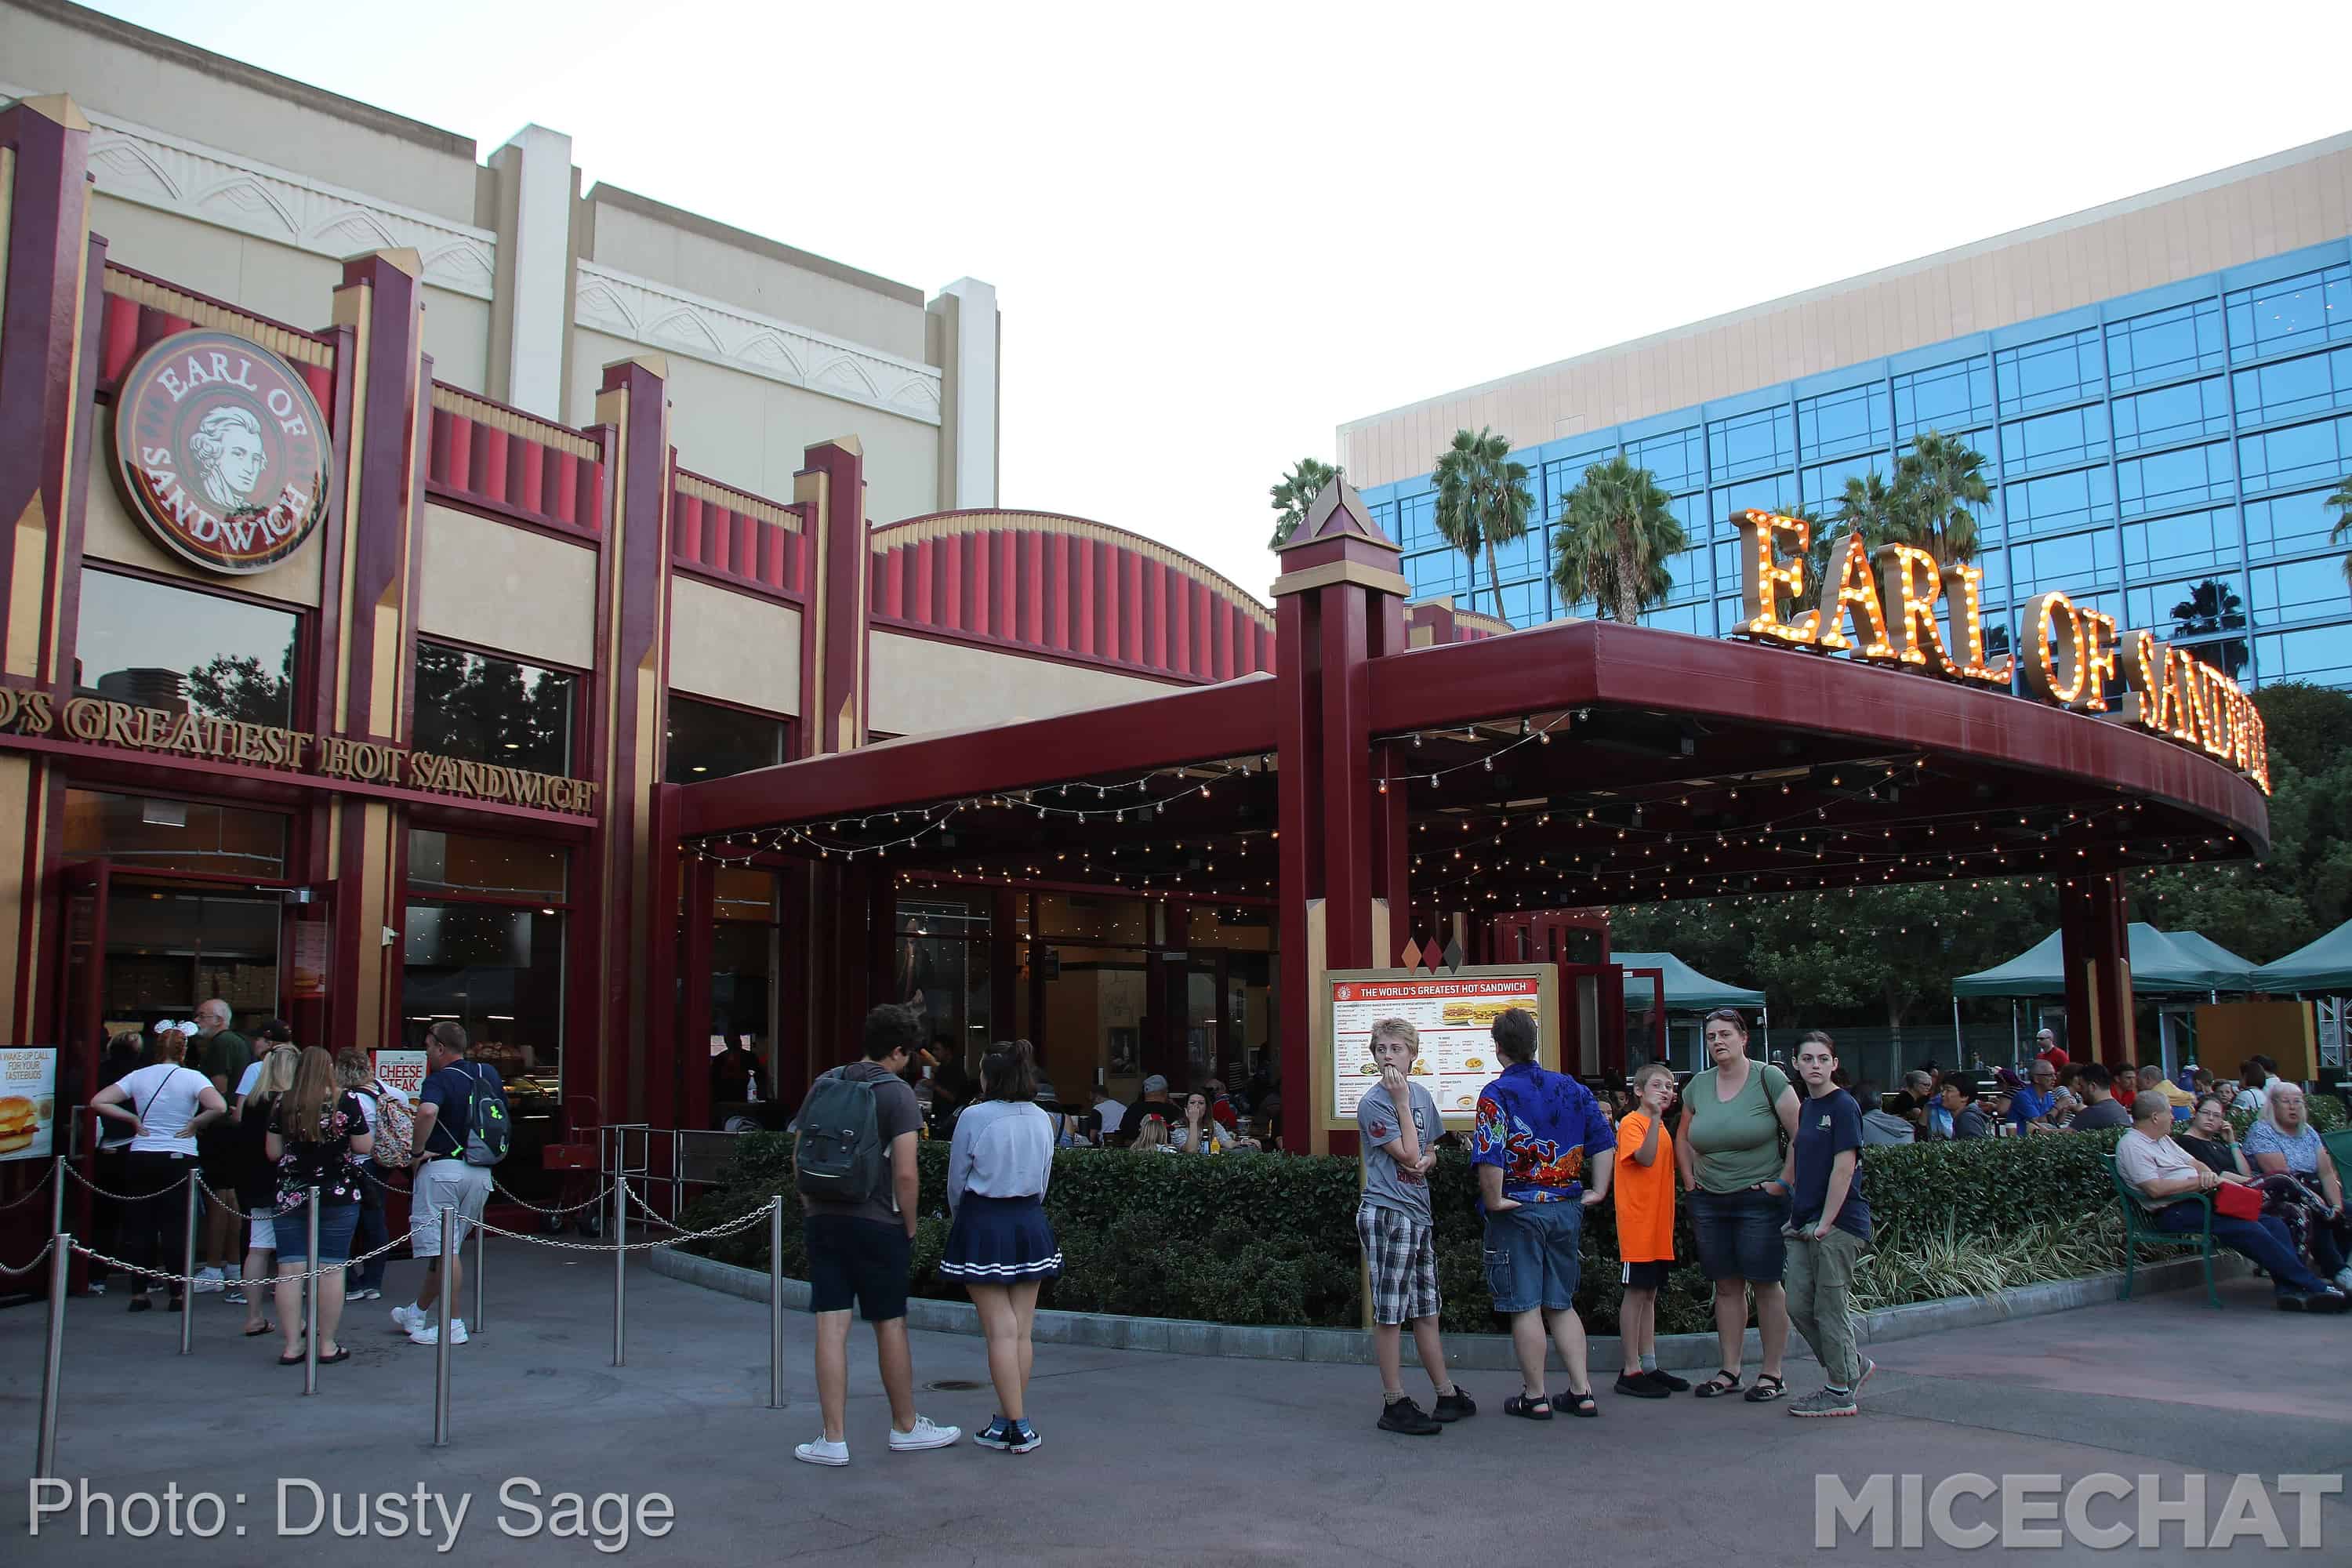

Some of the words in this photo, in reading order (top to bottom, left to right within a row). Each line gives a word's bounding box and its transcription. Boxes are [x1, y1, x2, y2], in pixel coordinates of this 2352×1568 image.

[156, 352, 258, 402] EARL
[267, 388, 308, 437] OF
[142, 446, 308, 552] SANDWICH
[1730, 508, 2014, 684] EARL
[2021, 591, 2115, 712] OF
[63, 698, 314, 768] GREATEST
[321, 736, 409, 783] HOT
[410, 752, 596, 812] SANDWICH
[1361, 988, 1377, 997] THE
[1379, 986, 1416, 996] WORLD'S
[1417, 985, 1461, 995] GREATEST
[1462, 984, 1479, 993] HOT
[1480, 982, 1526, 992] SANDWICH
[8, 1060, 21, 1070] FOR
[22, 1060, 40, 1070] YOUR
[379, 1065, 423, 1078] CHEESE
[5, 1071, 42, 1080] TASTEBUDS
[383, 1079, 419, 1091] TEAK.
